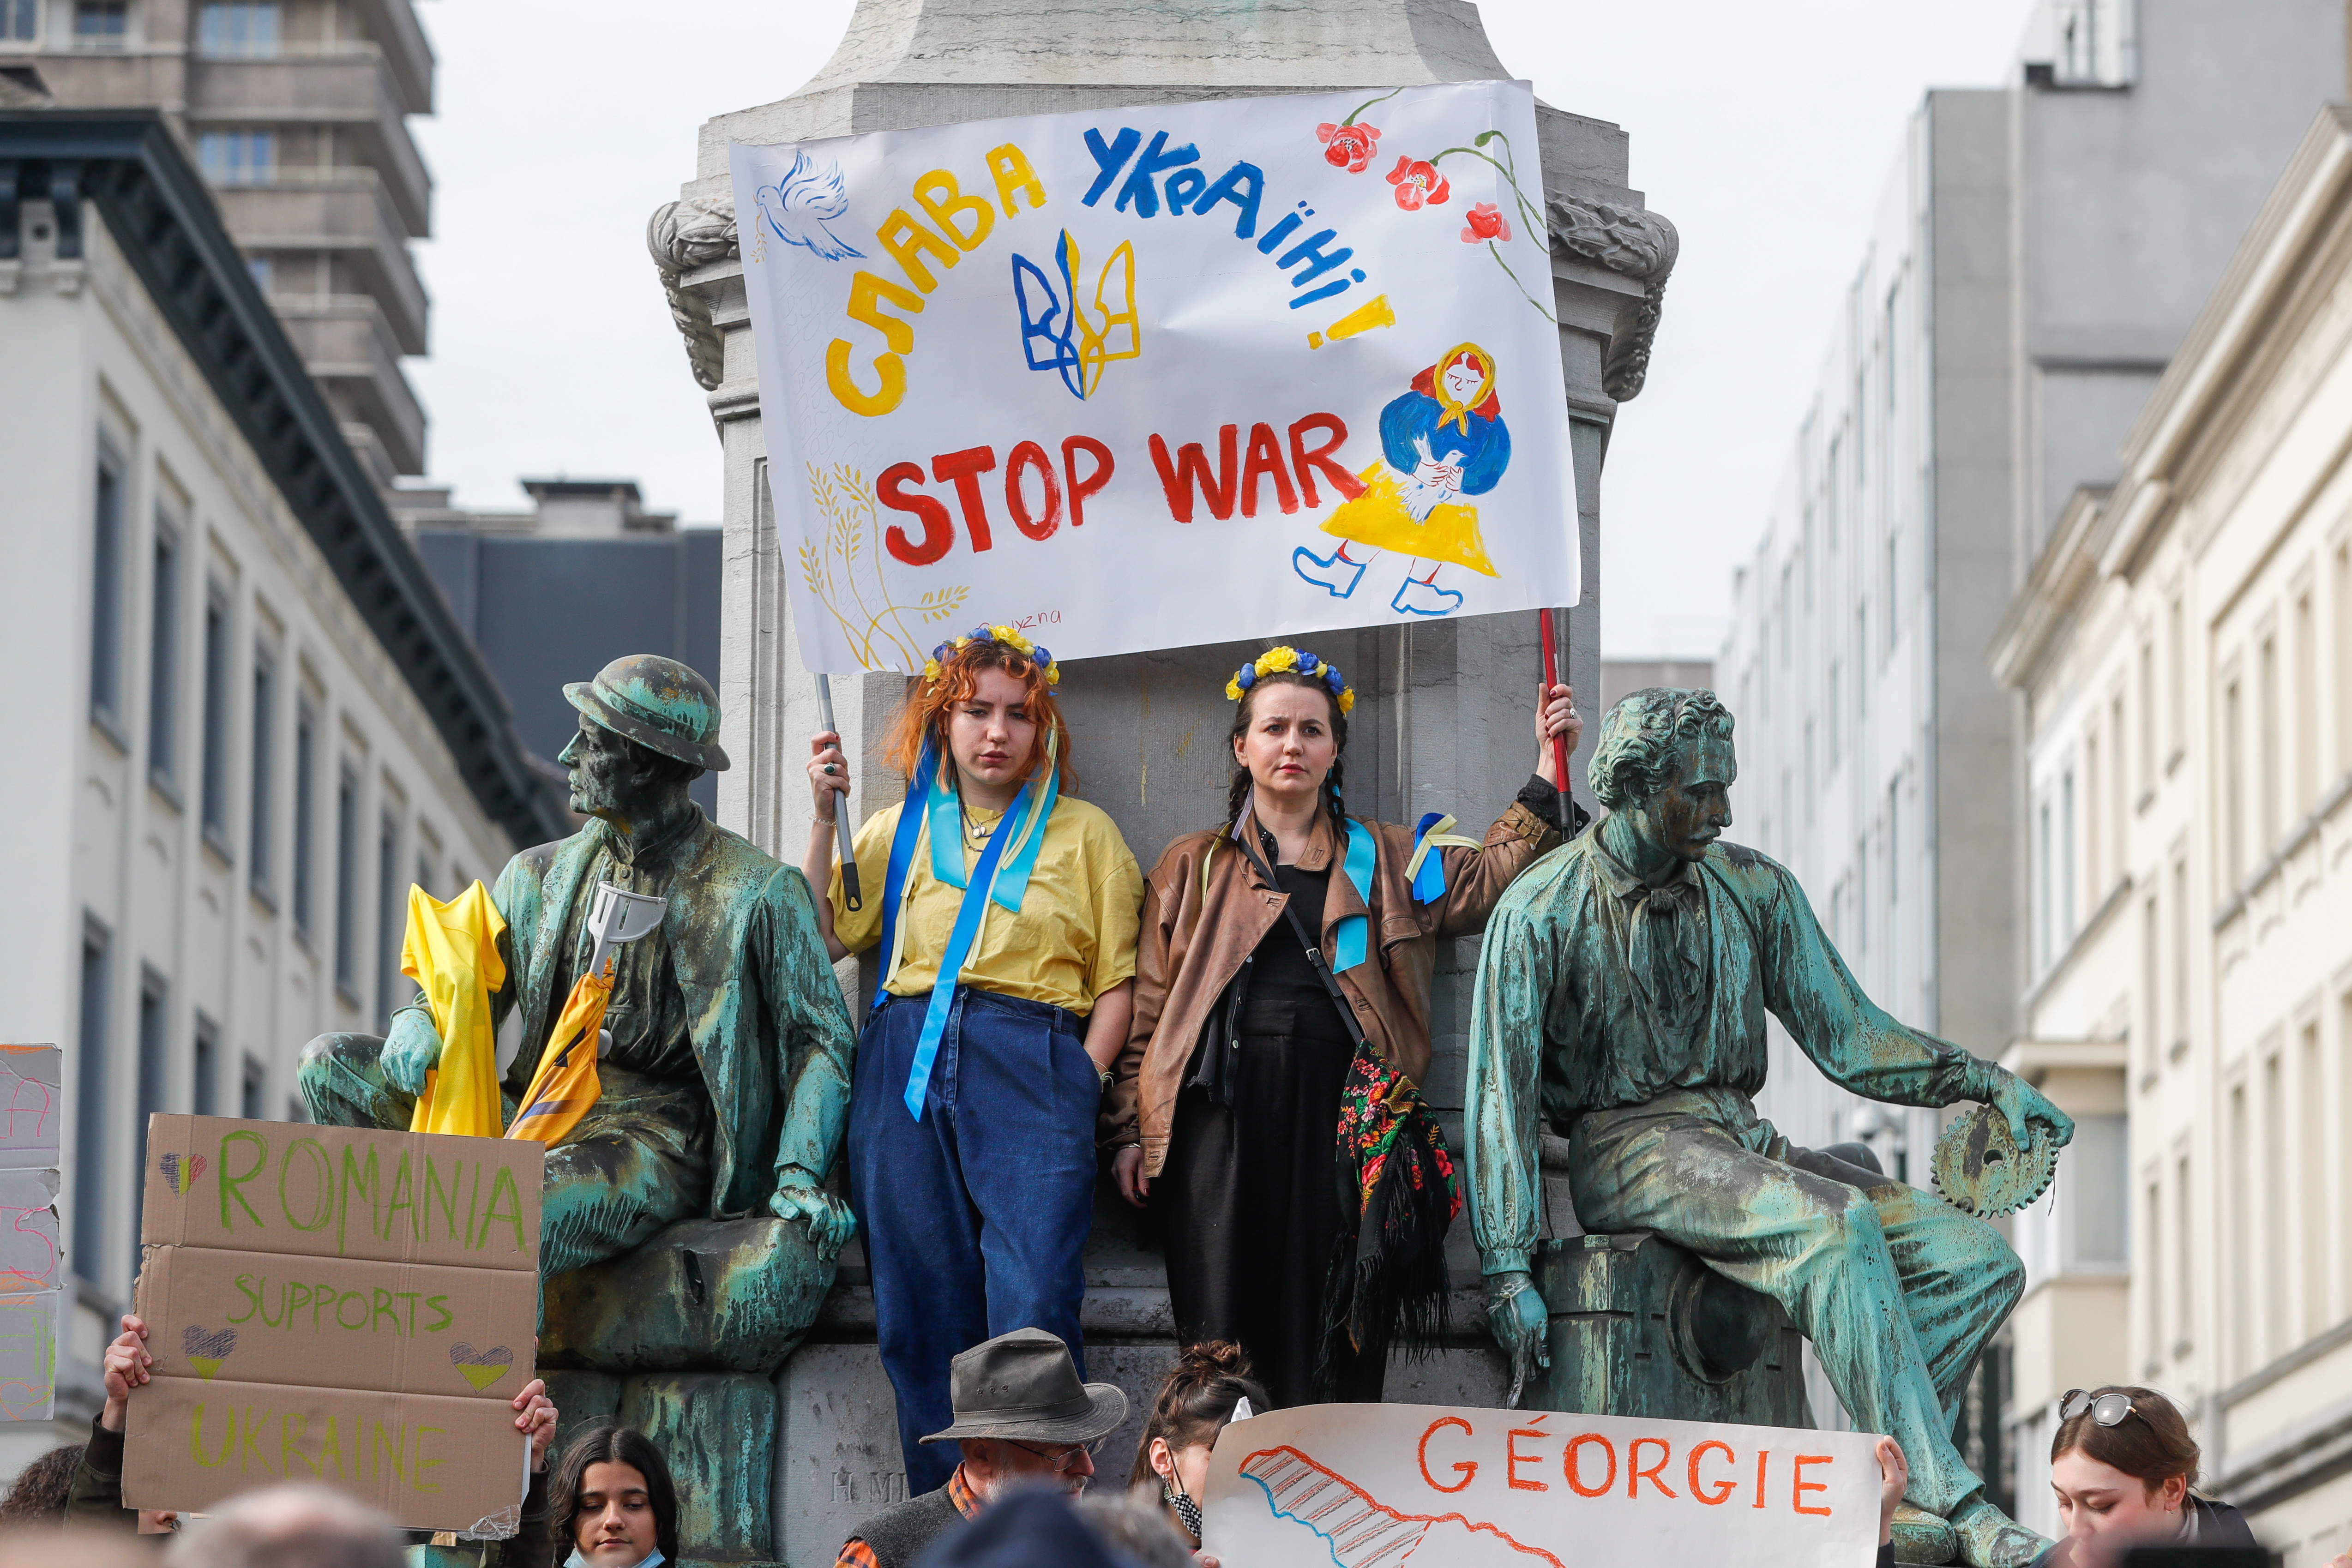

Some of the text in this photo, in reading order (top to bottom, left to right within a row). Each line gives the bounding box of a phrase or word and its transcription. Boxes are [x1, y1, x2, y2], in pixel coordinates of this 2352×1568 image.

[826, 143, 1047, 417] СЛАВА
[876, 412, 1369, 566] STOP WAR
[219, 1129, 529, 1258] ROMANIA
[227, 1274, 453, 1338] SUPPORTS
[189, 1401, 448, 1494] UKRAINE
[1416, 1414, 1834, 1517] GÉORGIE
